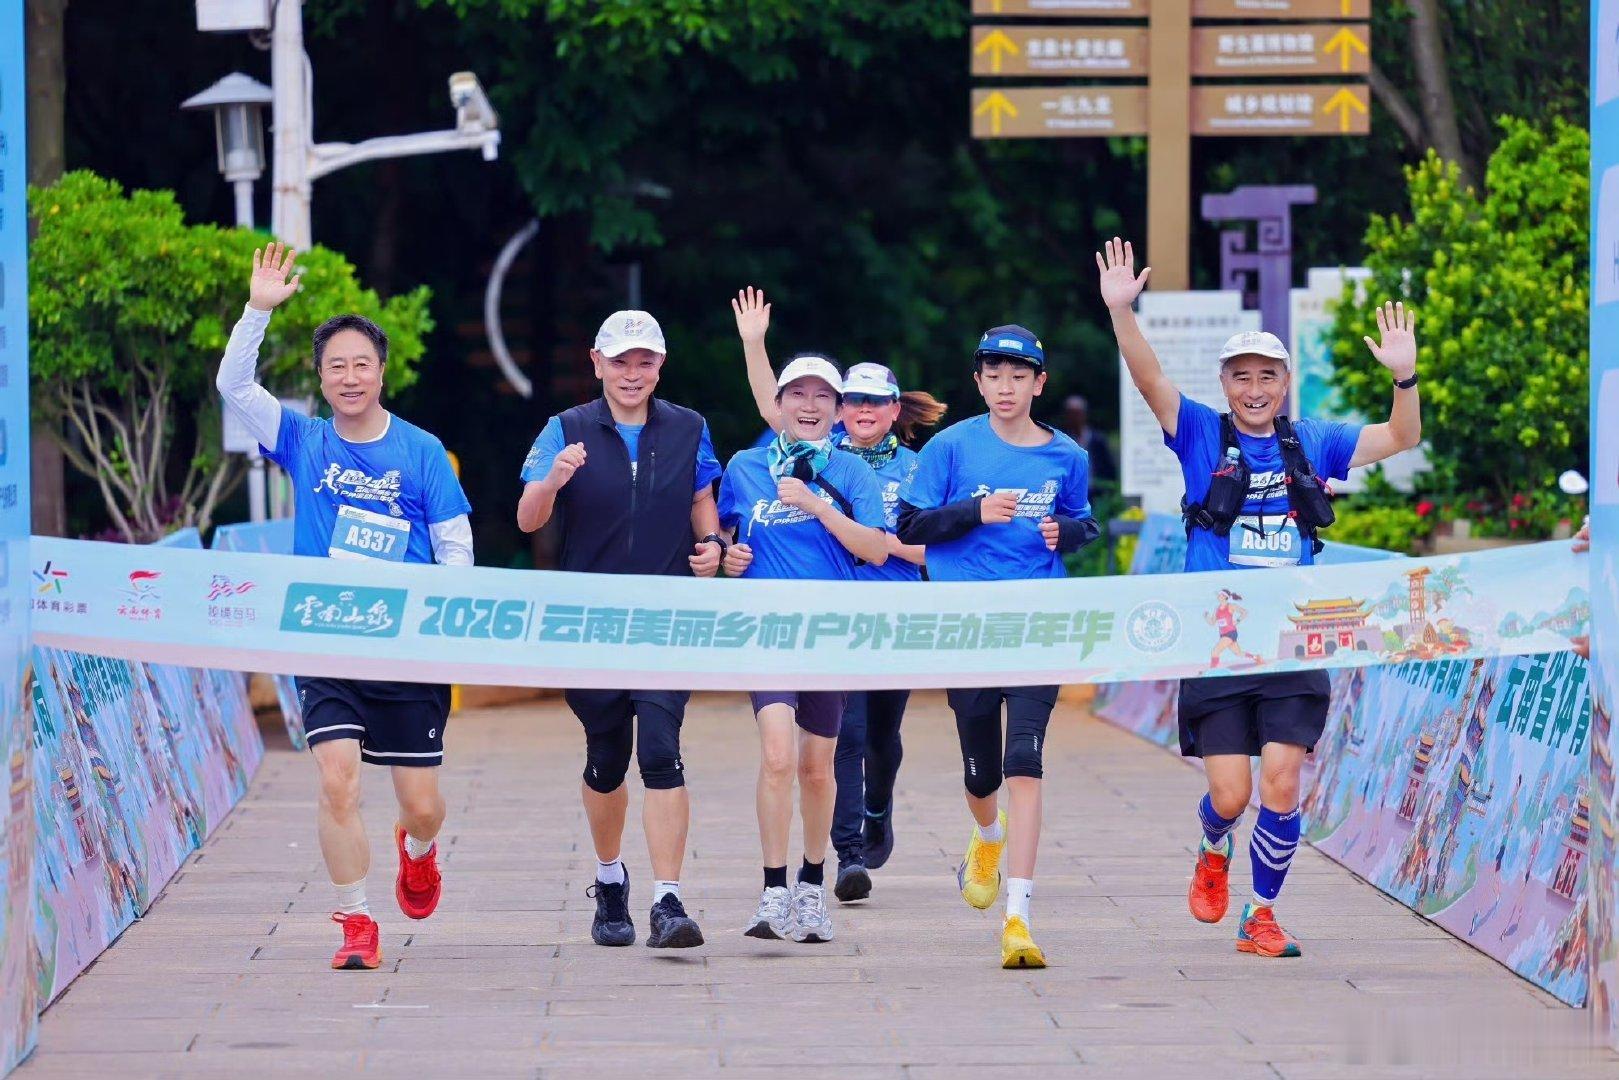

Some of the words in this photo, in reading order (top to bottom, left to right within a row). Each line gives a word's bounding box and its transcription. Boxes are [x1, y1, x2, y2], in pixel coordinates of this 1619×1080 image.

[344, 524, 396, 554] A337
[31, 598, 88, 615] 体育彩票
[418, 595, 528, 641] 2026
[538, 603, 1116, 662] 云南美丽乡村户外运动嘉年华
